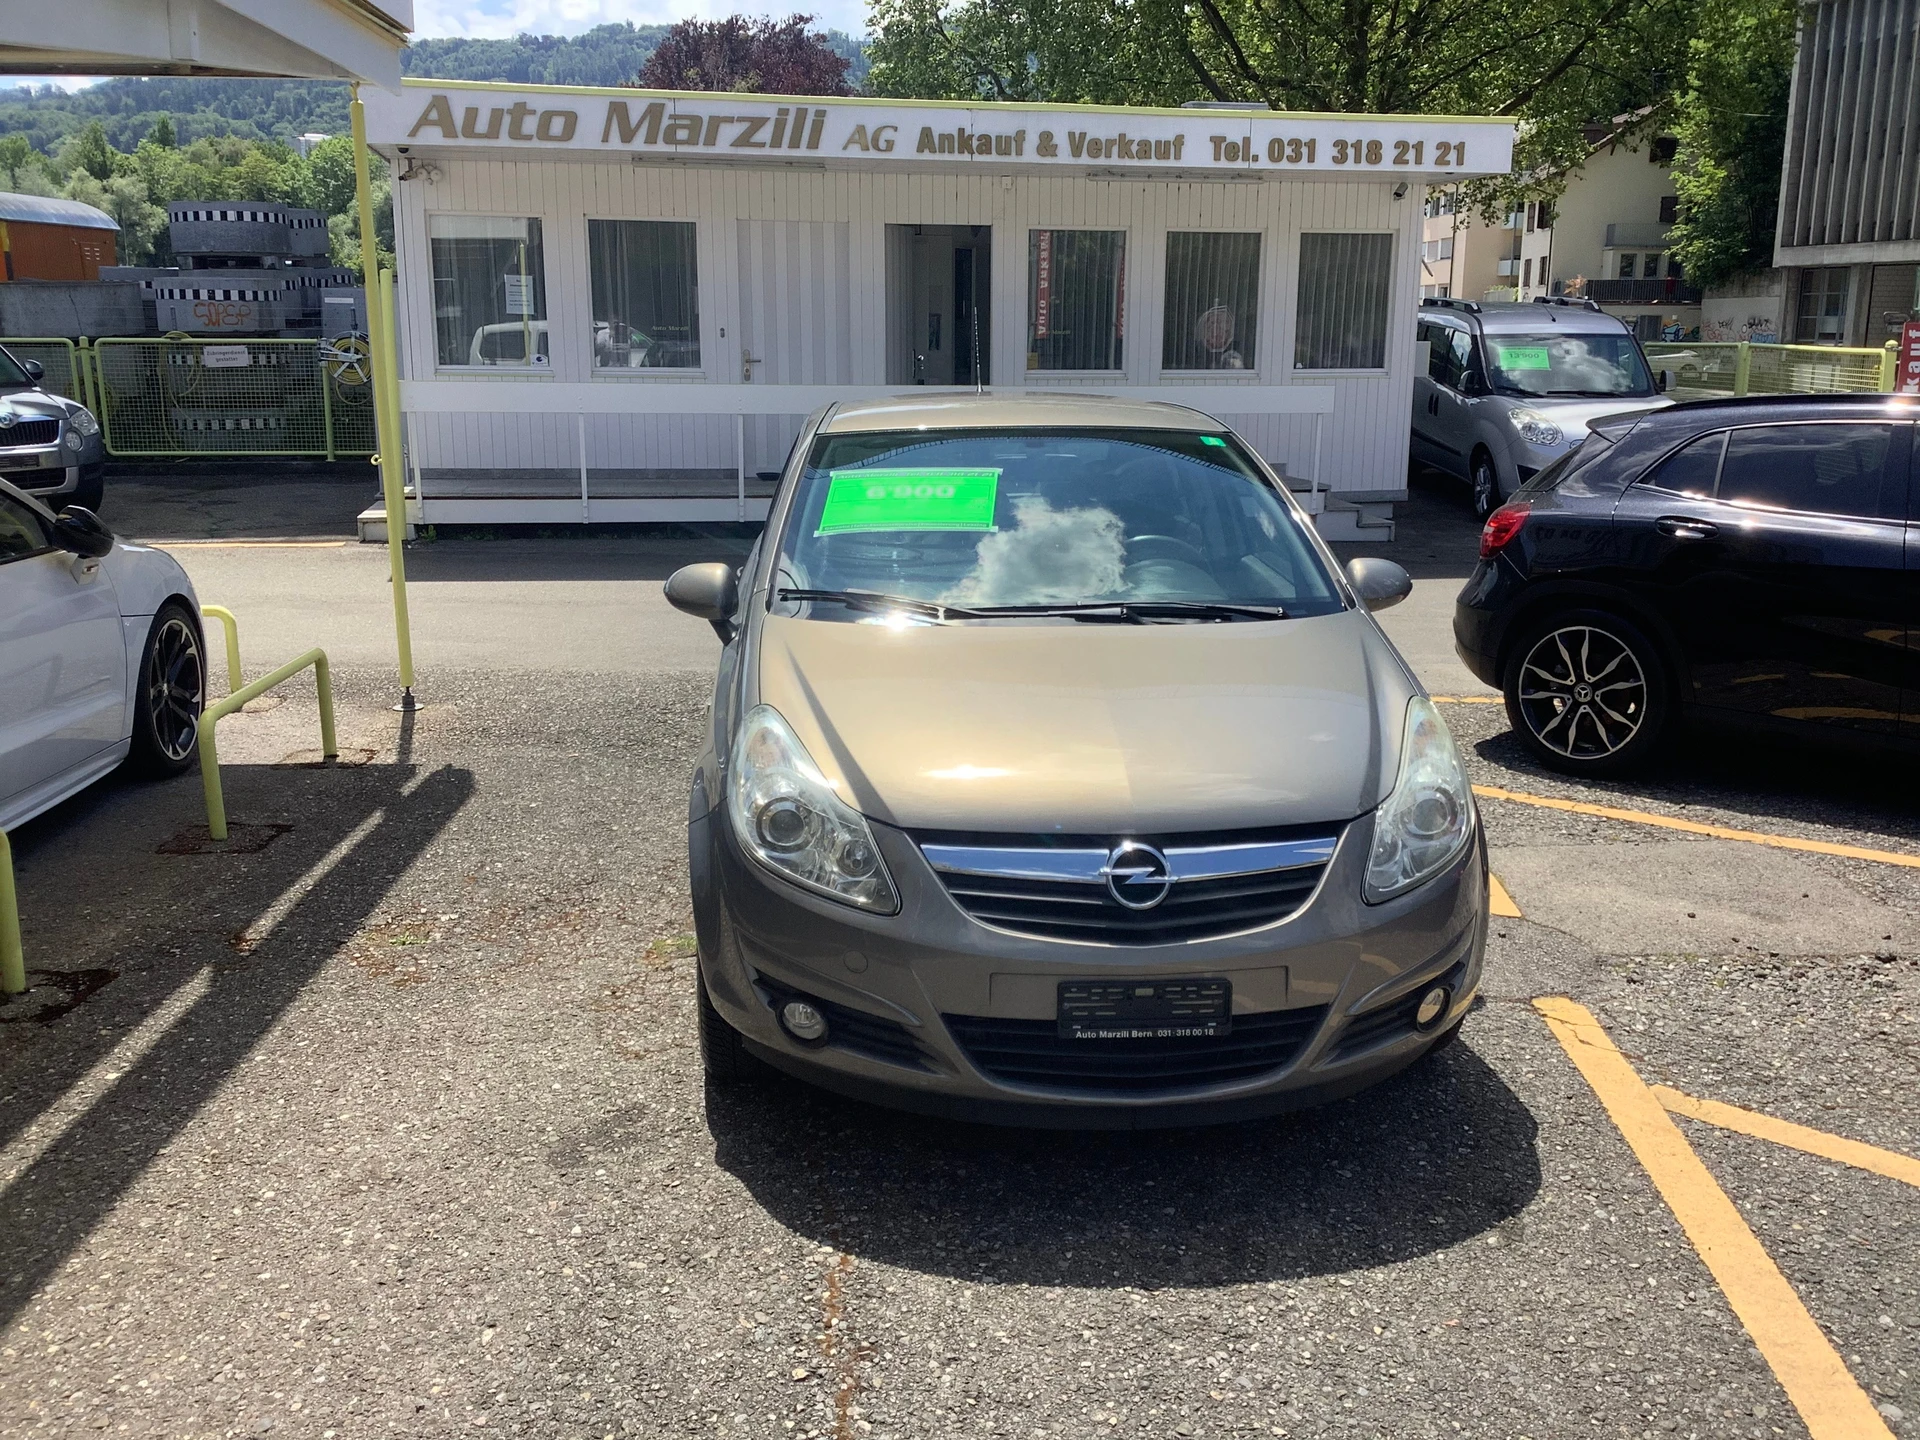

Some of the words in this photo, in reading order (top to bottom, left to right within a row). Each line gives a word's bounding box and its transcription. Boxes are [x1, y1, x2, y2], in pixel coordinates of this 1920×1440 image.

[407, 95, 578, 142] Auto
[600, 101, 826, 150] Marzili
[842, 124, 898, 153] AG
[916, 126, 1025, 156] Ankauf
[1036, 130, 1059, 158] &
[1068, 130, 1185, 160] Verkauf
[1210, 135, 1259, 164] Tel.
[1267, 136, 1316, 164] 031
[1332, 138, 1382, 165] 318
[1393, 140, 1424, 166] 21
[1435, 141, 1466, 166] 21
[865, 484, 957, 500] 6'900
[1075, 1030, 1097, 1039] Auto
[1099, 1030, 1129, 1038] Marzili
[1131, 1030, 1153, 1038] Bern
[1157, 1029, 1172, 1037] 031
[1176, 1028, 1191, 1037] 318
[1192, 1028, 1203, 1036] 00
[1204, 1028, 1214, 1036] 18
